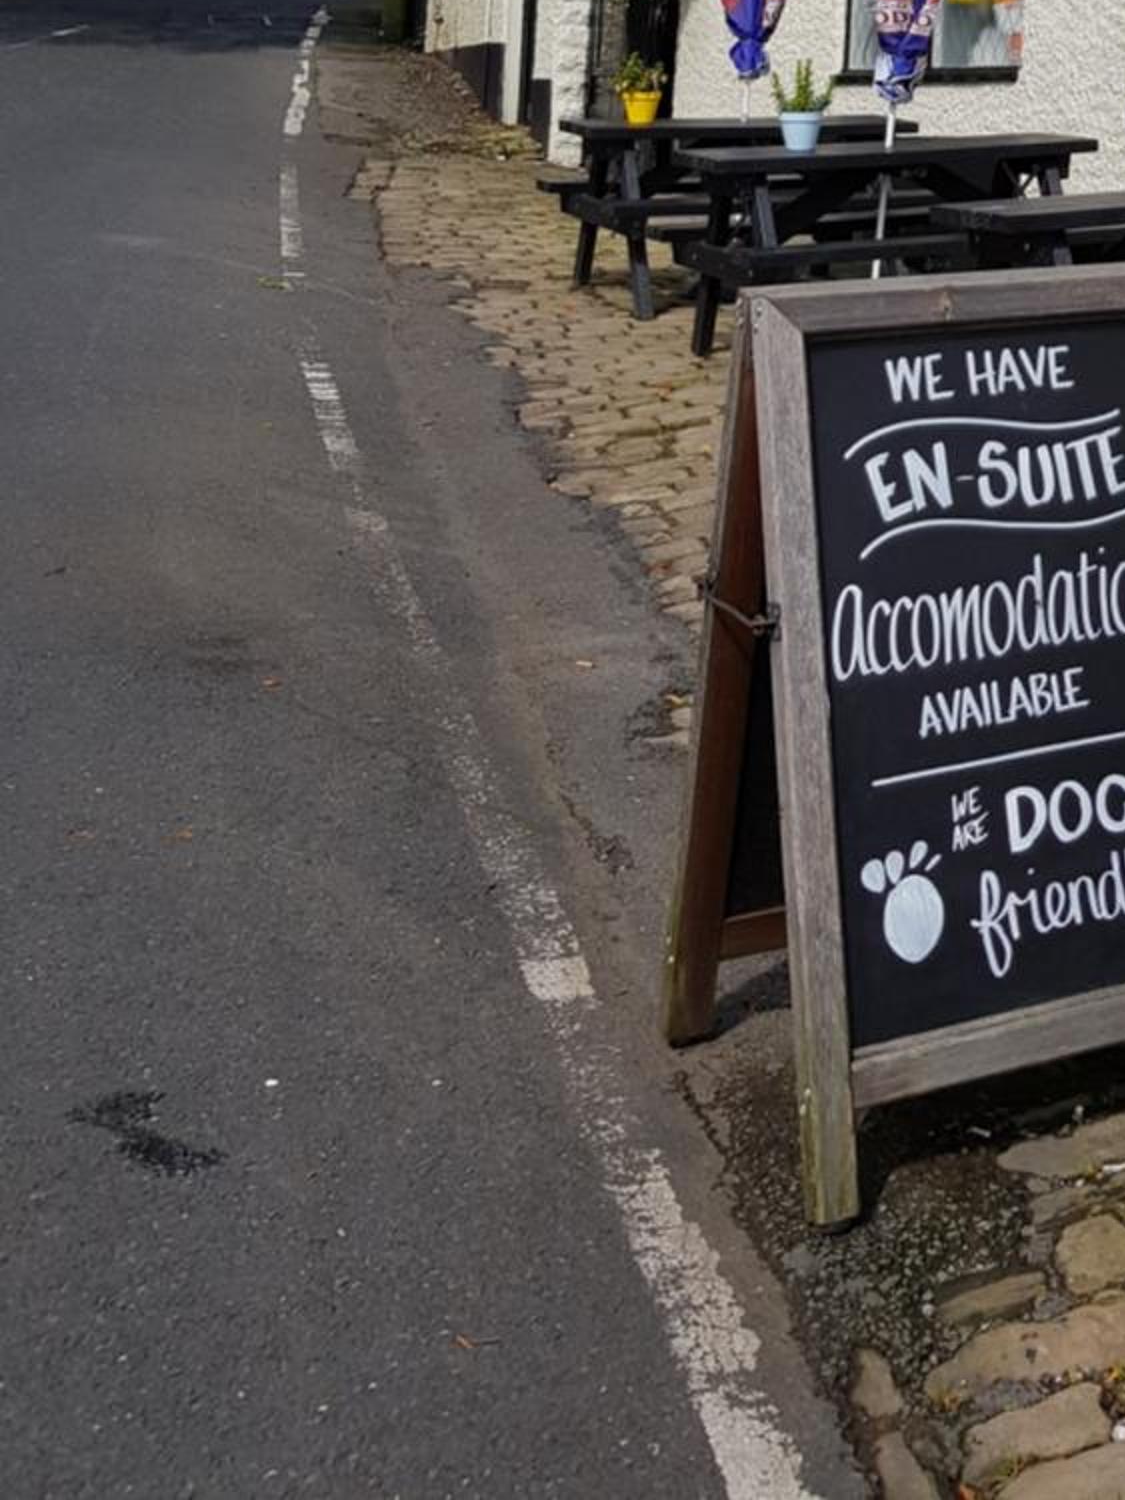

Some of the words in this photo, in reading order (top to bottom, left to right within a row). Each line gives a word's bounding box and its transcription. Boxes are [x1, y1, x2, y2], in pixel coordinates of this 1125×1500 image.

[884, 353, 955, 402] WE
[966, 345, 1075, 395] HAVE
[918, 666, 1090, 739] AVAILABLE
[951, 785, 983, 820] WE
[951, 817, 990, 853] ARE
